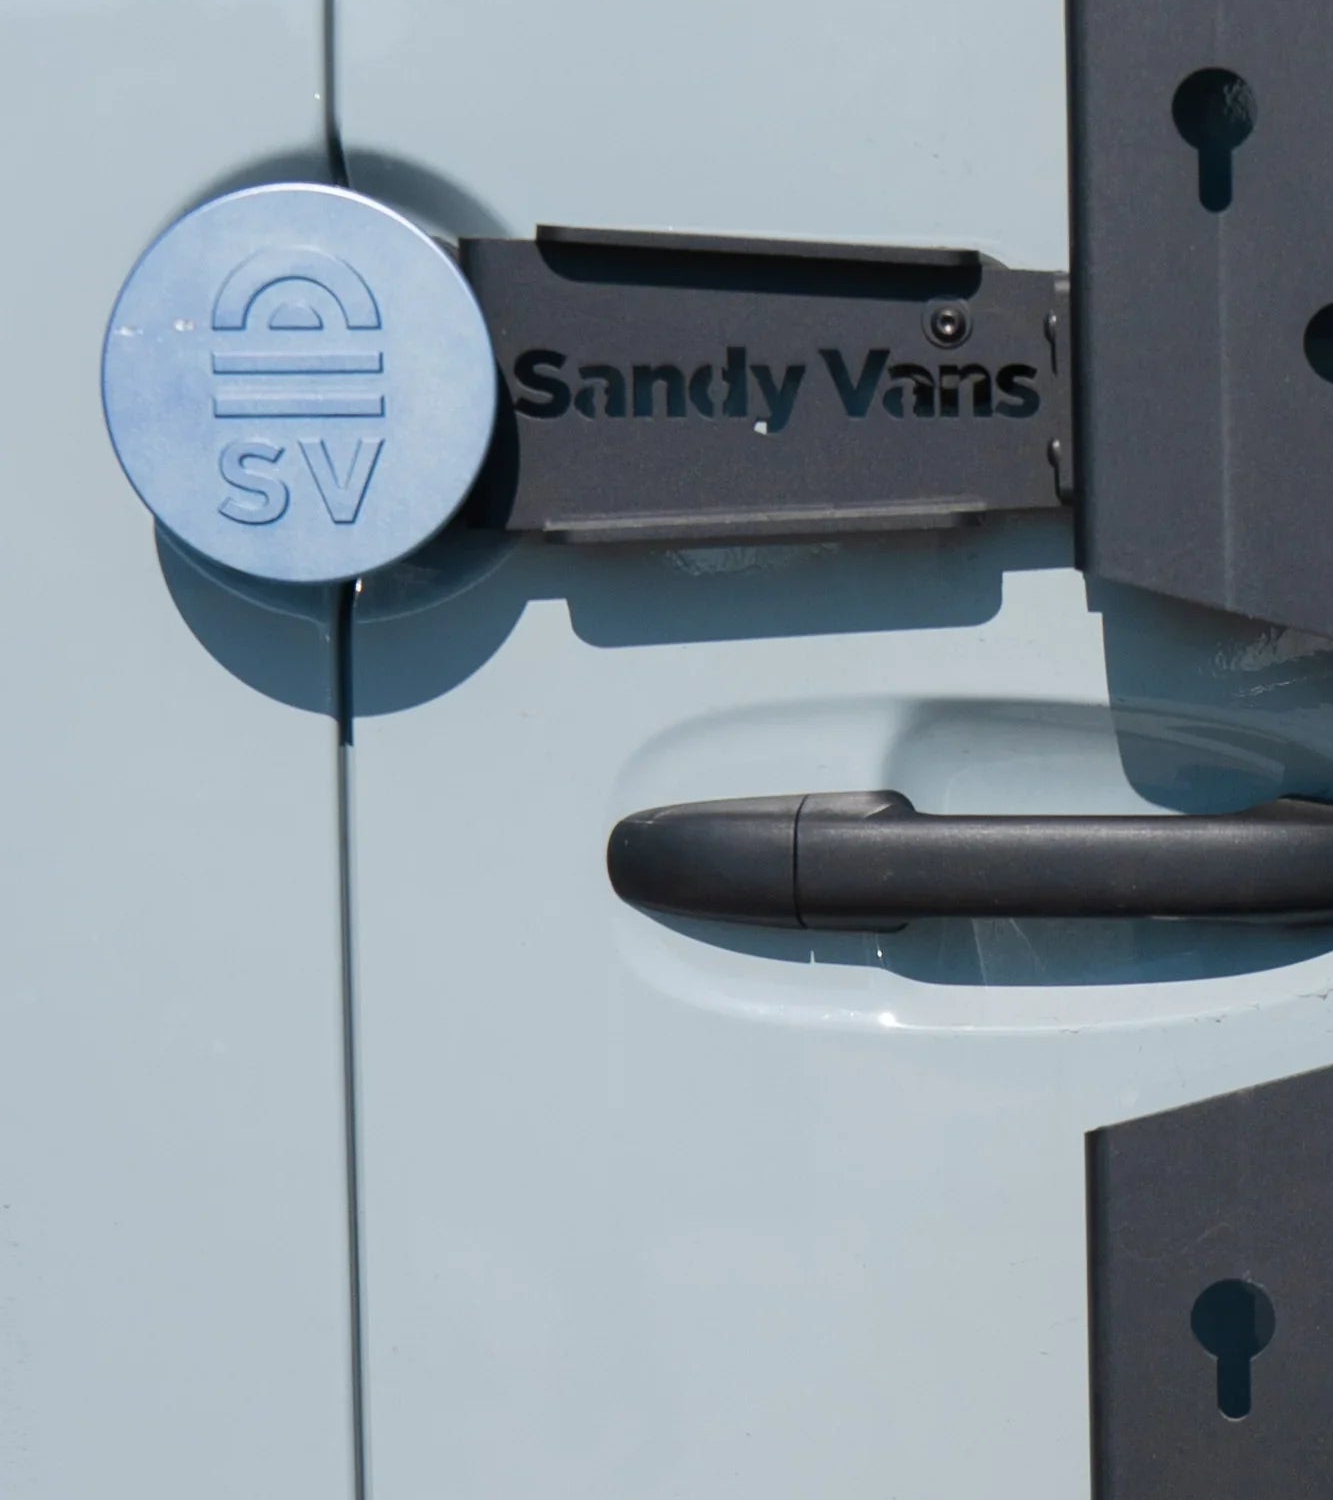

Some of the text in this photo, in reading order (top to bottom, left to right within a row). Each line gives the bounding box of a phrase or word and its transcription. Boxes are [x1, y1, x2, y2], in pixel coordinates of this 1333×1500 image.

[510, 345, 1041, 434] Sandy Vans
[217, 435, 386, 527] SV
